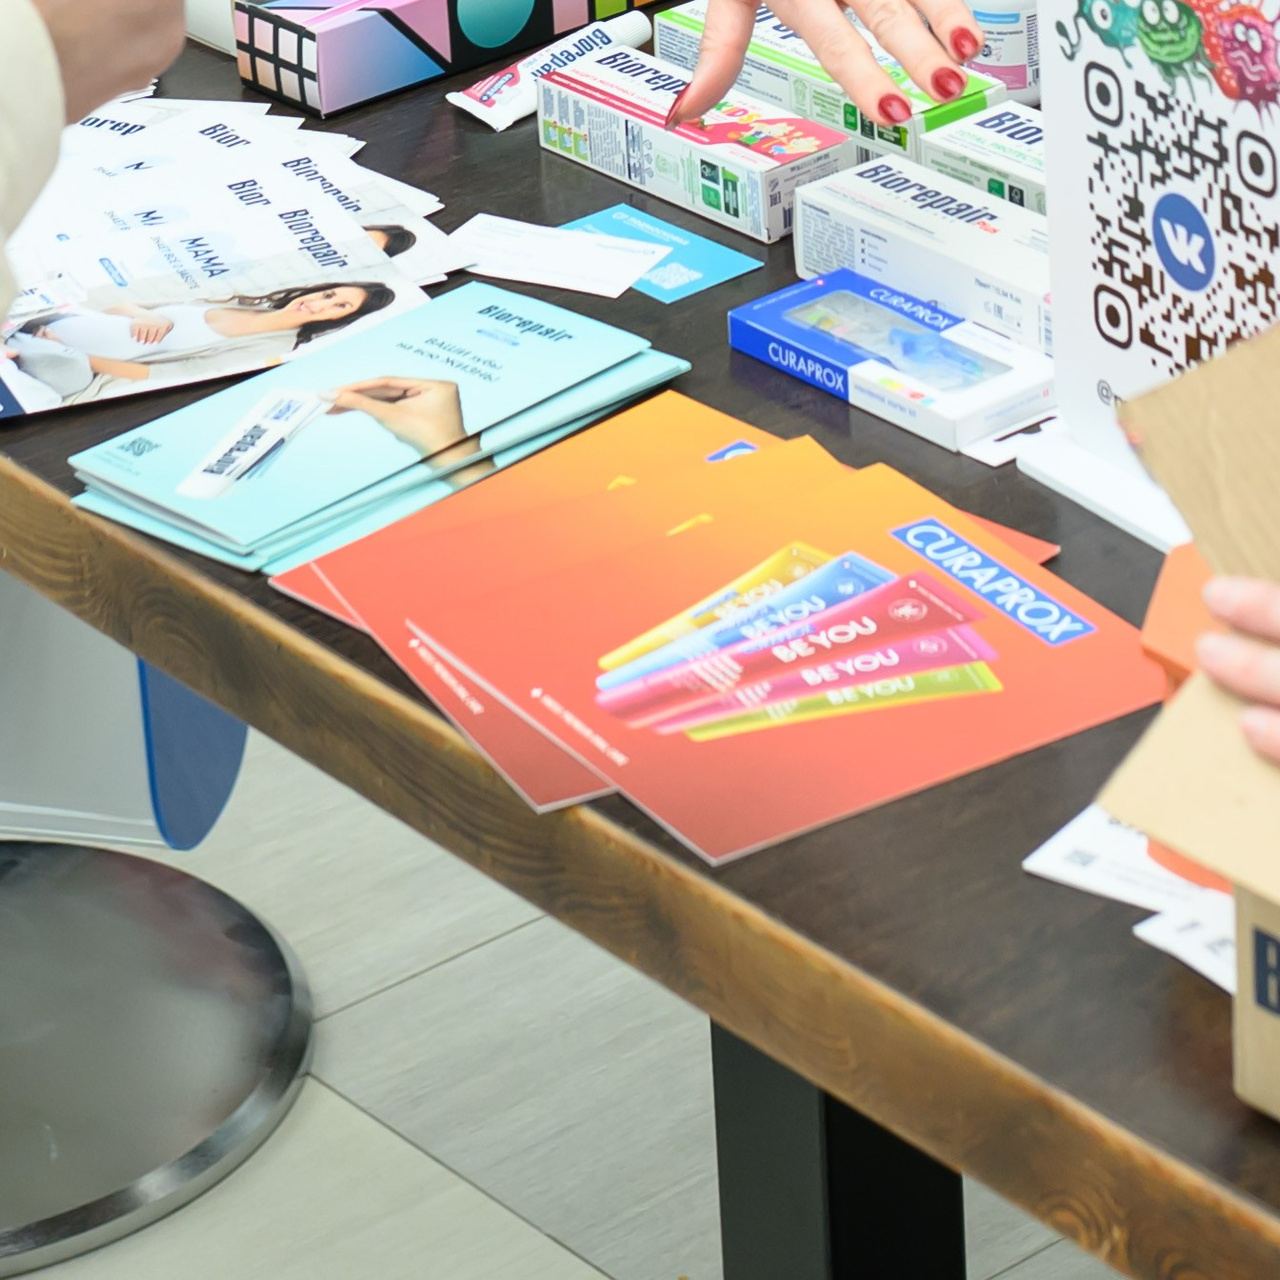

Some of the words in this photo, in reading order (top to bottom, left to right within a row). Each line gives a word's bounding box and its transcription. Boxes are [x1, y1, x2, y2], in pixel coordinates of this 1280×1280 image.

[855, 163, 999, 224] Biorepair
[278, 208, 349, 269] Biorepair
[477, 304, 574, 342] Biorepair
[869, 288, 953, 329] CURAPROX
[768, 341, 845, 393] CURAPROX
[905, 523, 1084, 641] CURAPROX
[770, 594, 826, 623] YOU
[771, 638, 816, 663] BE
[808, 615, 877, 649] YOU
[801, 663, 840, 686] BE
[834, 647, 900, 676] YOU
[826, 686, 860, 706] BE
[857, 675, 916, 700] YOU
